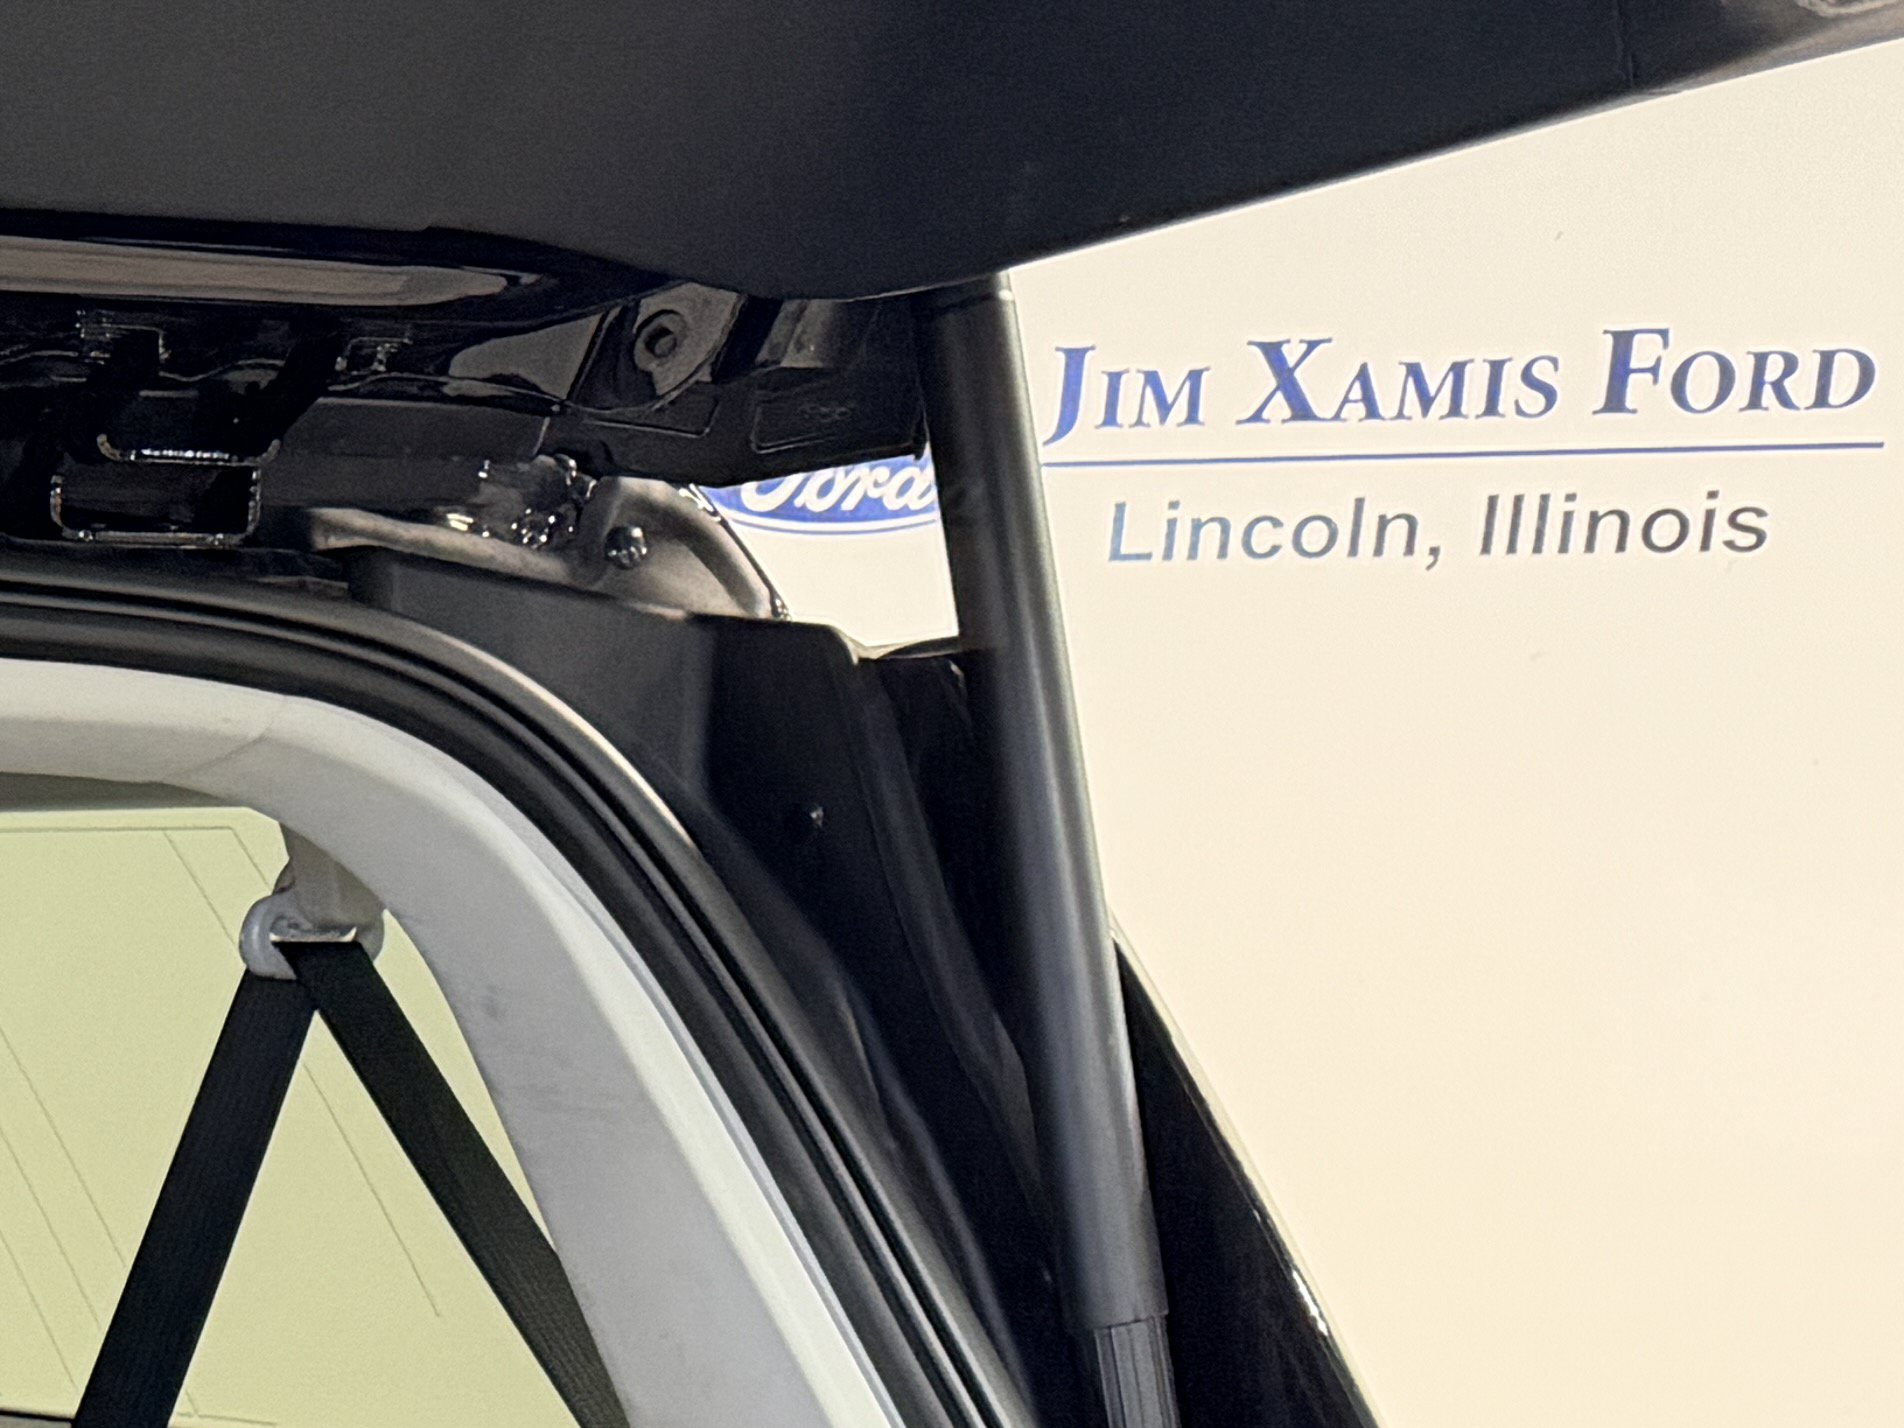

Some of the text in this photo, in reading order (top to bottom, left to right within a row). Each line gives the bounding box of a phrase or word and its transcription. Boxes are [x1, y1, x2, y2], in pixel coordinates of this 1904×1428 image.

[1043, 327, 1877, 447] JIM XAMIS FORD
[1109, 489, 1769, 572] Lincoln, Illinois
